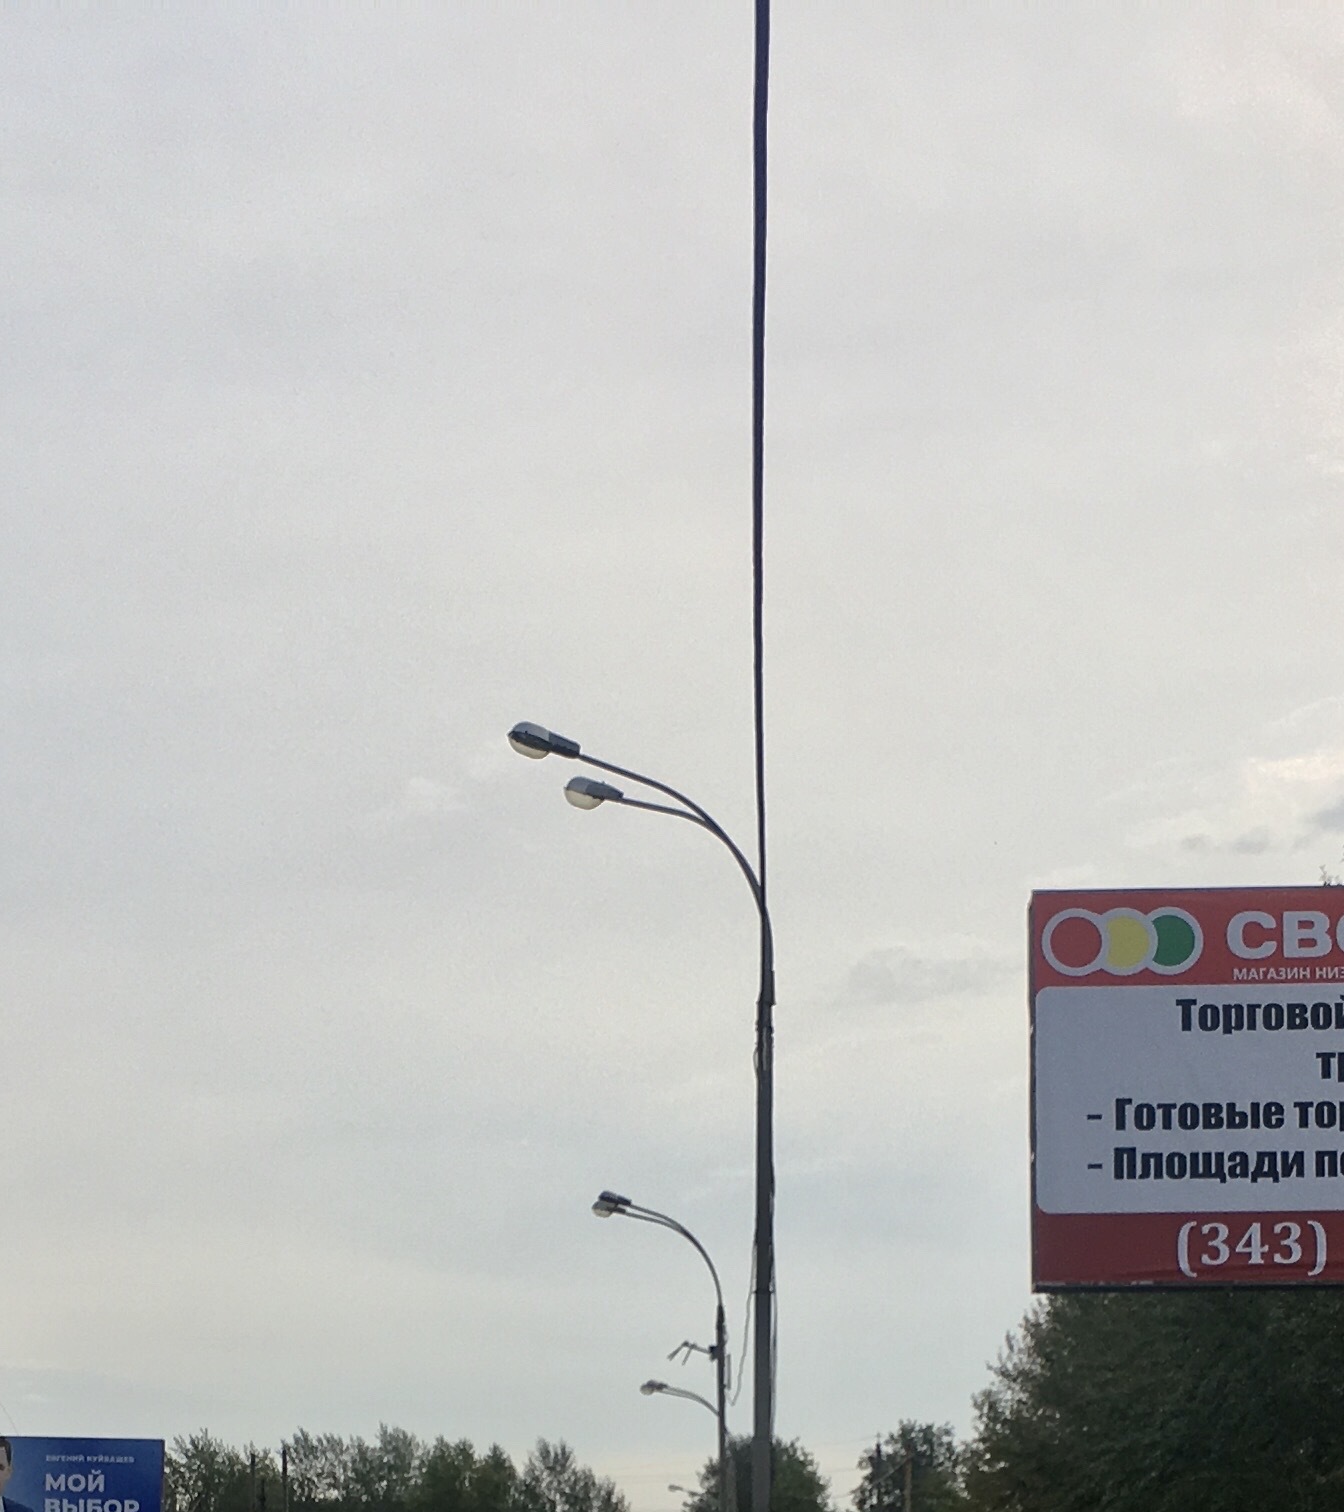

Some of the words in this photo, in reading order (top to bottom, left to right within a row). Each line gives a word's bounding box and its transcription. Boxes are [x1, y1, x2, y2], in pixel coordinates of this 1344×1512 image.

[1233, 967, 1310, 981] МАГАЗИН
[1115, 1097, 1285, 1131] Готовые
[1113, 1146, 1305, 1183] Площади
[1176, 1219, 1327, 1278] (343)
[44, 1468, 106, 1493] МОЙ
